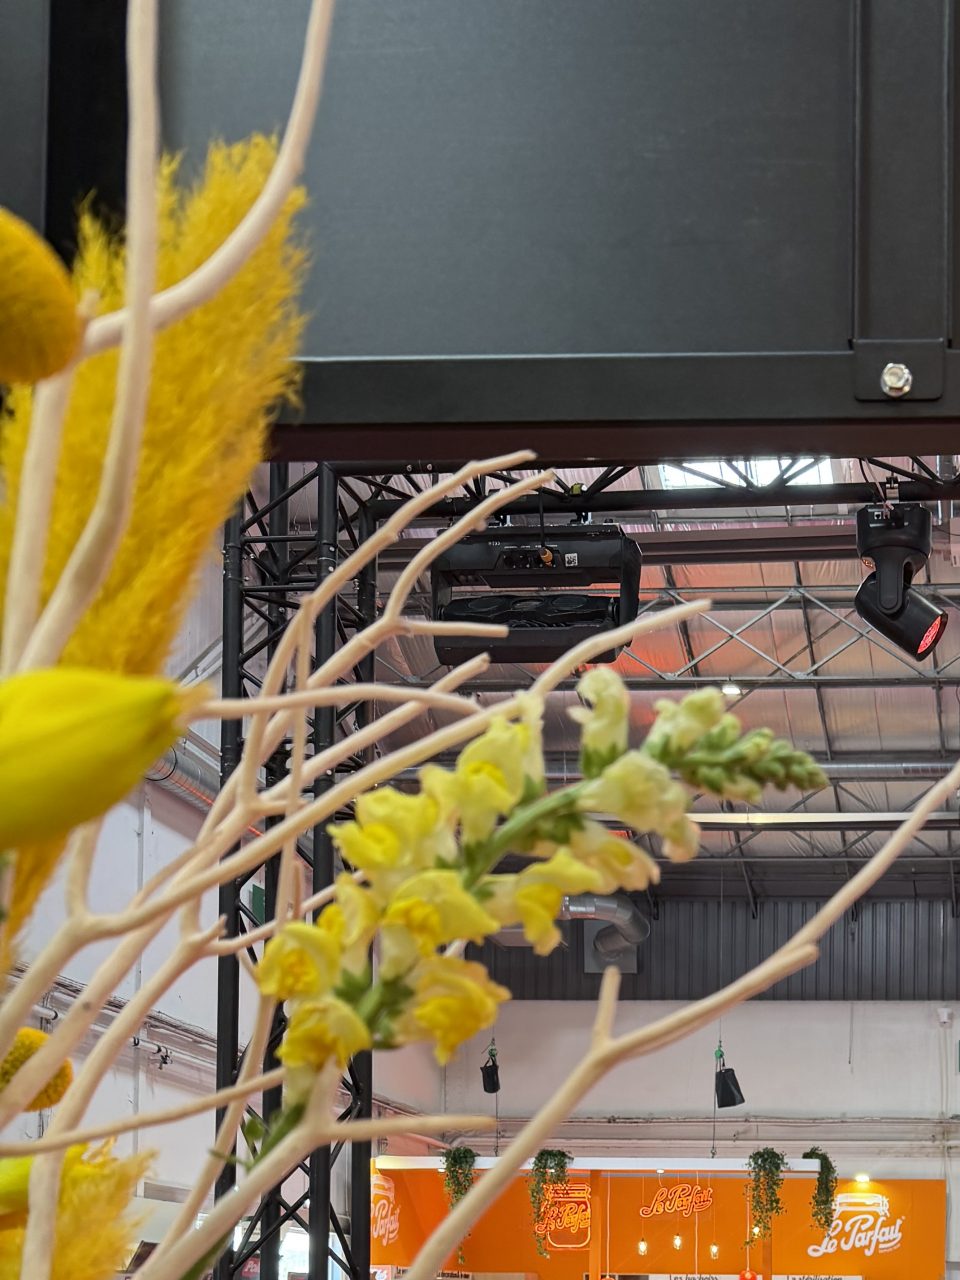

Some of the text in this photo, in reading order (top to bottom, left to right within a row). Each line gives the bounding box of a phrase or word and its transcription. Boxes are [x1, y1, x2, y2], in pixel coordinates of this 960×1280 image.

[640, 1183, 713, 1217] Le Parfait
[807, 1214, 903, 1257] Le Parfait
